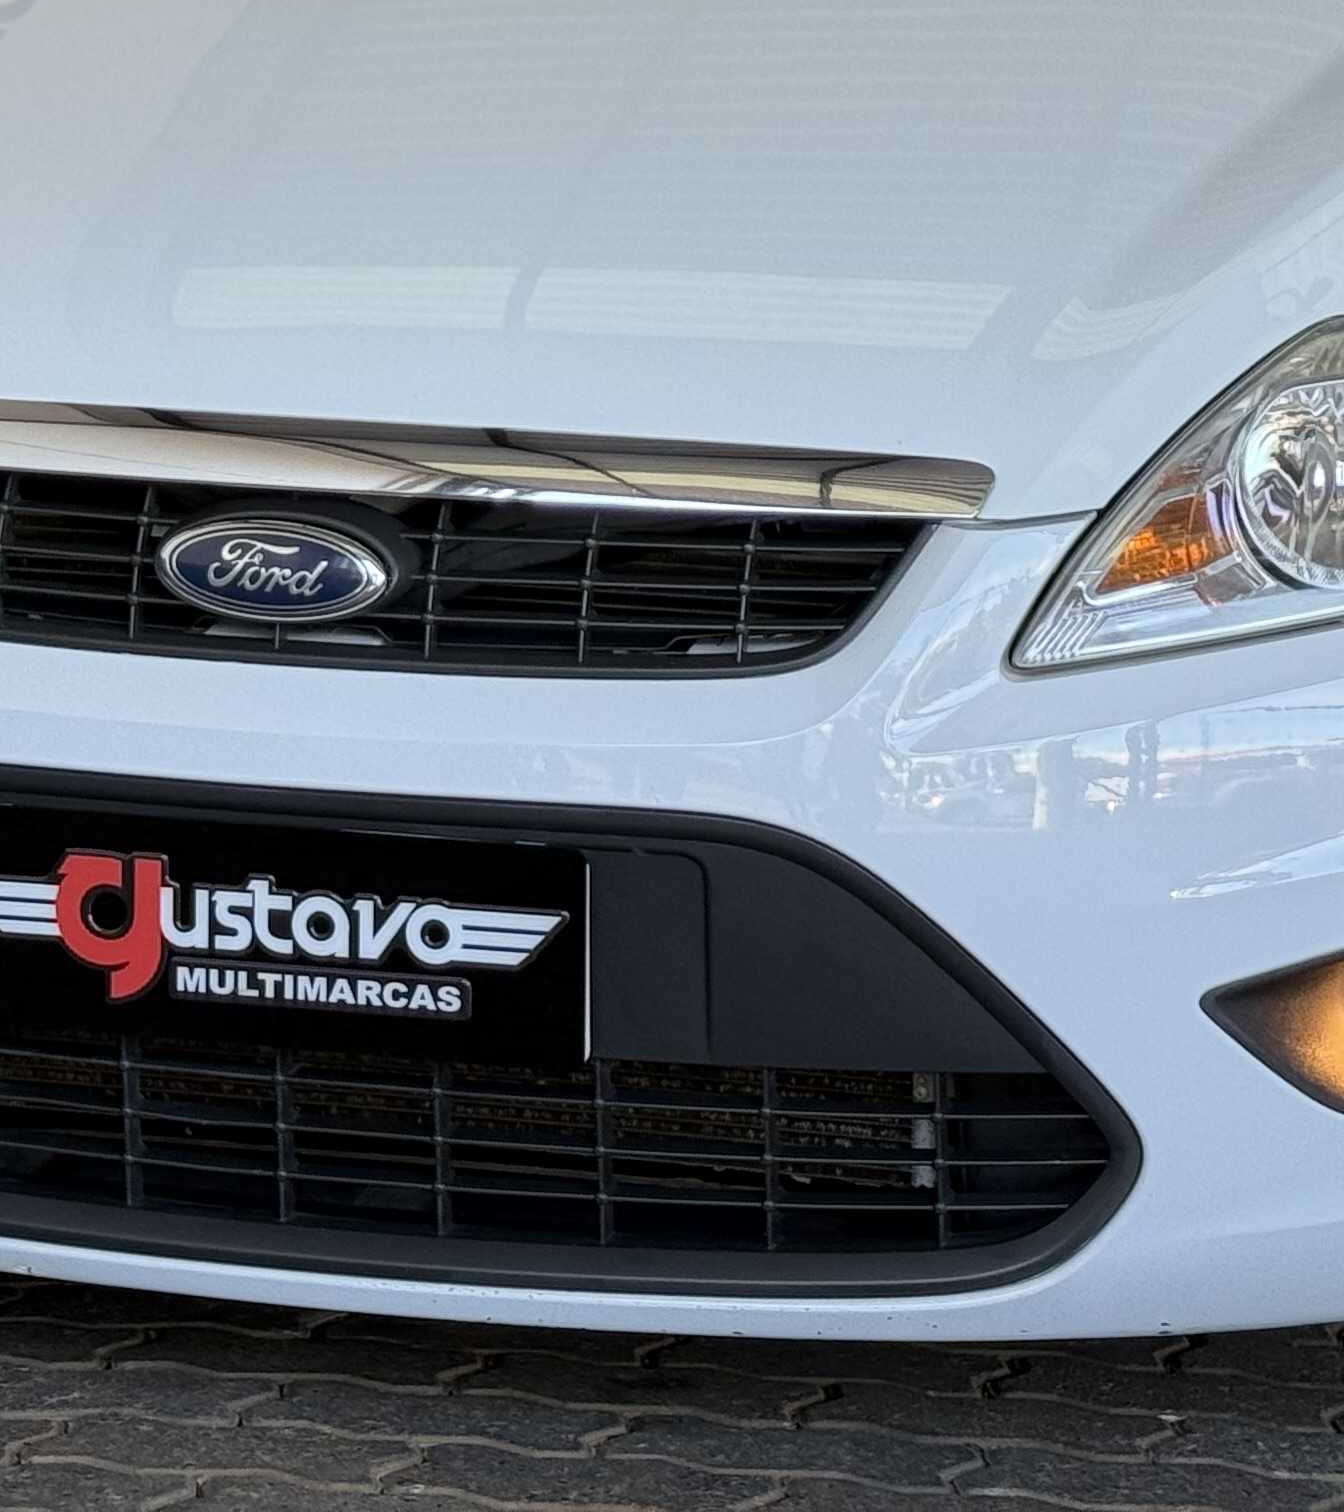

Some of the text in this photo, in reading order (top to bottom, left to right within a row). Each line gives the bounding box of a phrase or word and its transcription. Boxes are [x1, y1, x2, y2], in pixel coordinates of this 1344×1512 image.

[207, 538, 329, 597] Ford
[56, 849, 464, 1001] gustavo
[176, 965, 463, 1013] MULTIMARCAS
